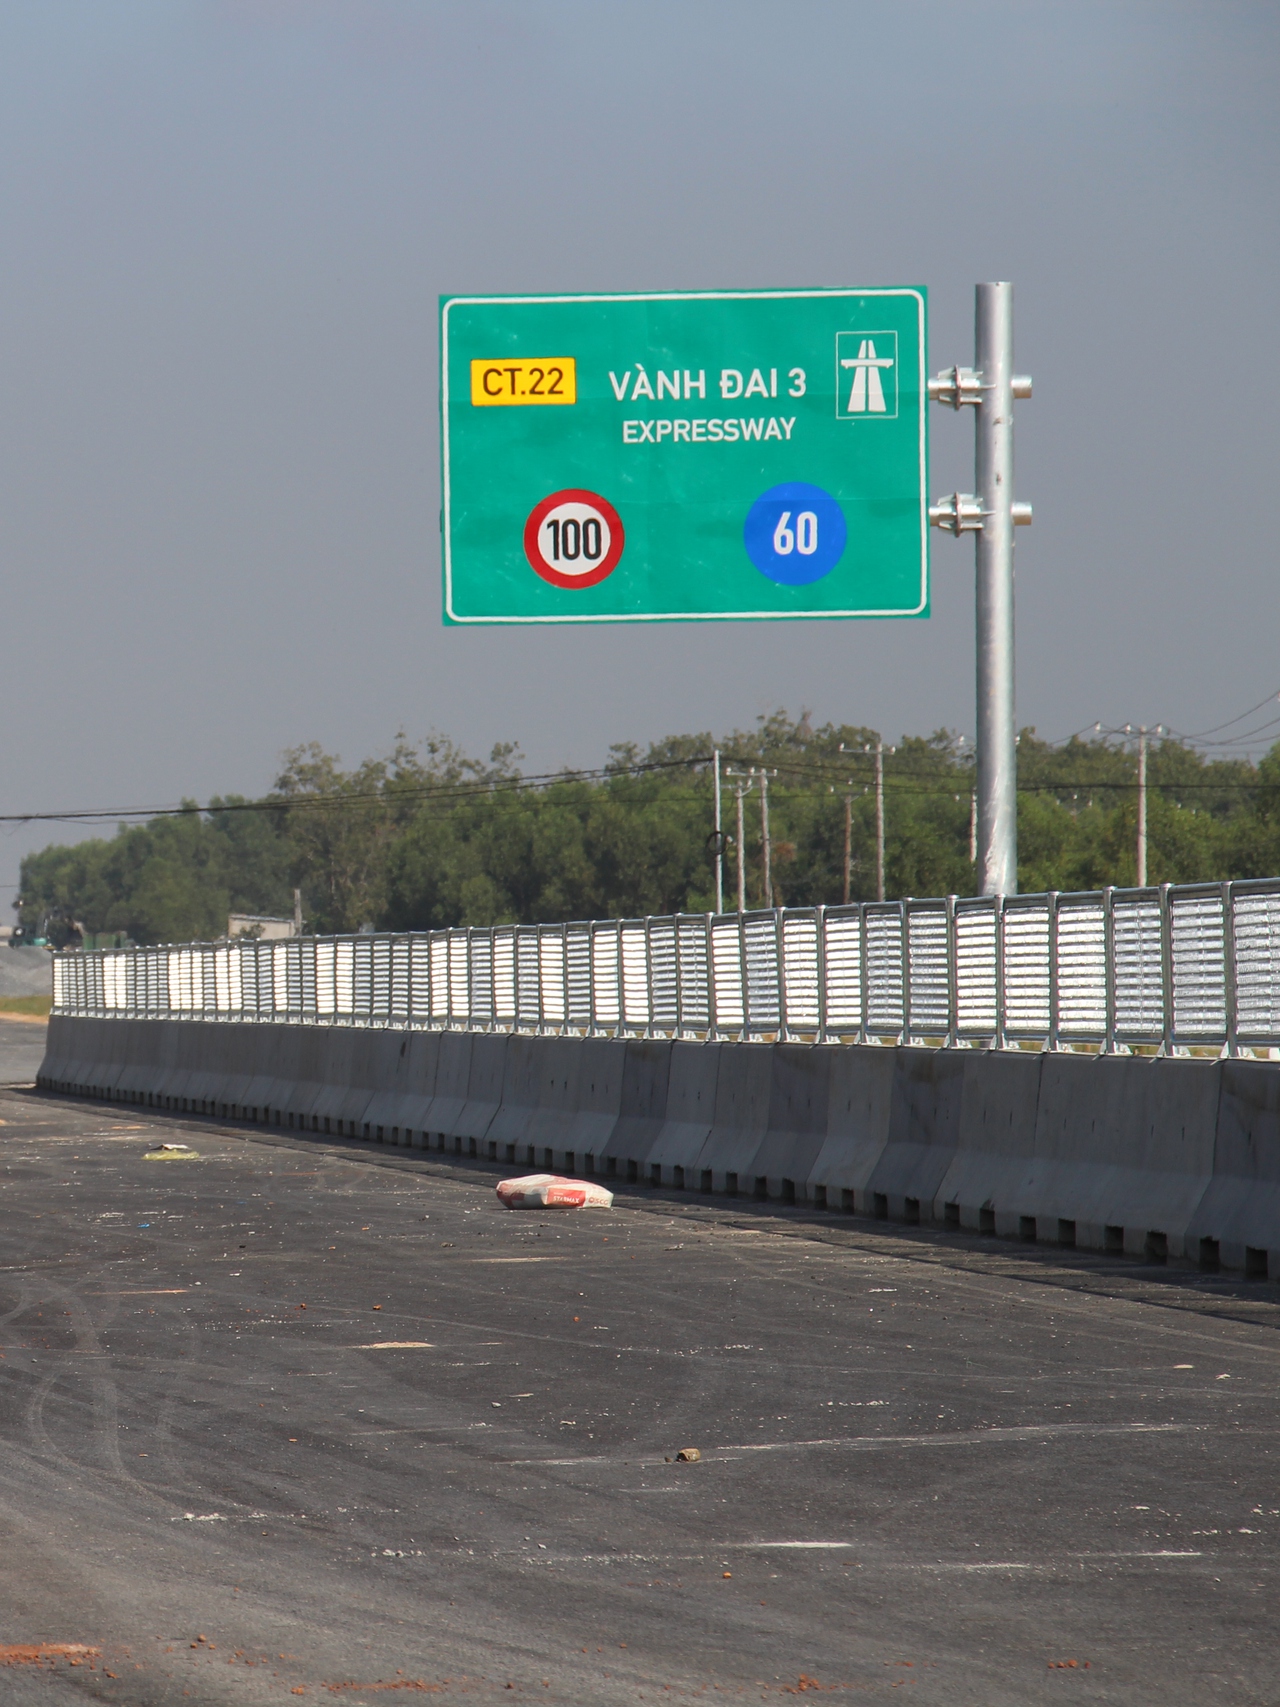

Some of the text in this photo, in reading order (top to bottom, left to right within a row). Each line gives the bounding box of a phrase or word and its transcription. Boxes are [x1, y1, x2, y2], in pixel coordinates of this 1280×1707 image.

[482, 367, 564, 396] CT.22
[609, 364, 807, 401] VÀNH ĐAI 3
[622, 417, 796, 443] EXPRESSWAY
[547, 518, 602, 561] 100
[773, 511, 819, 556] 60
